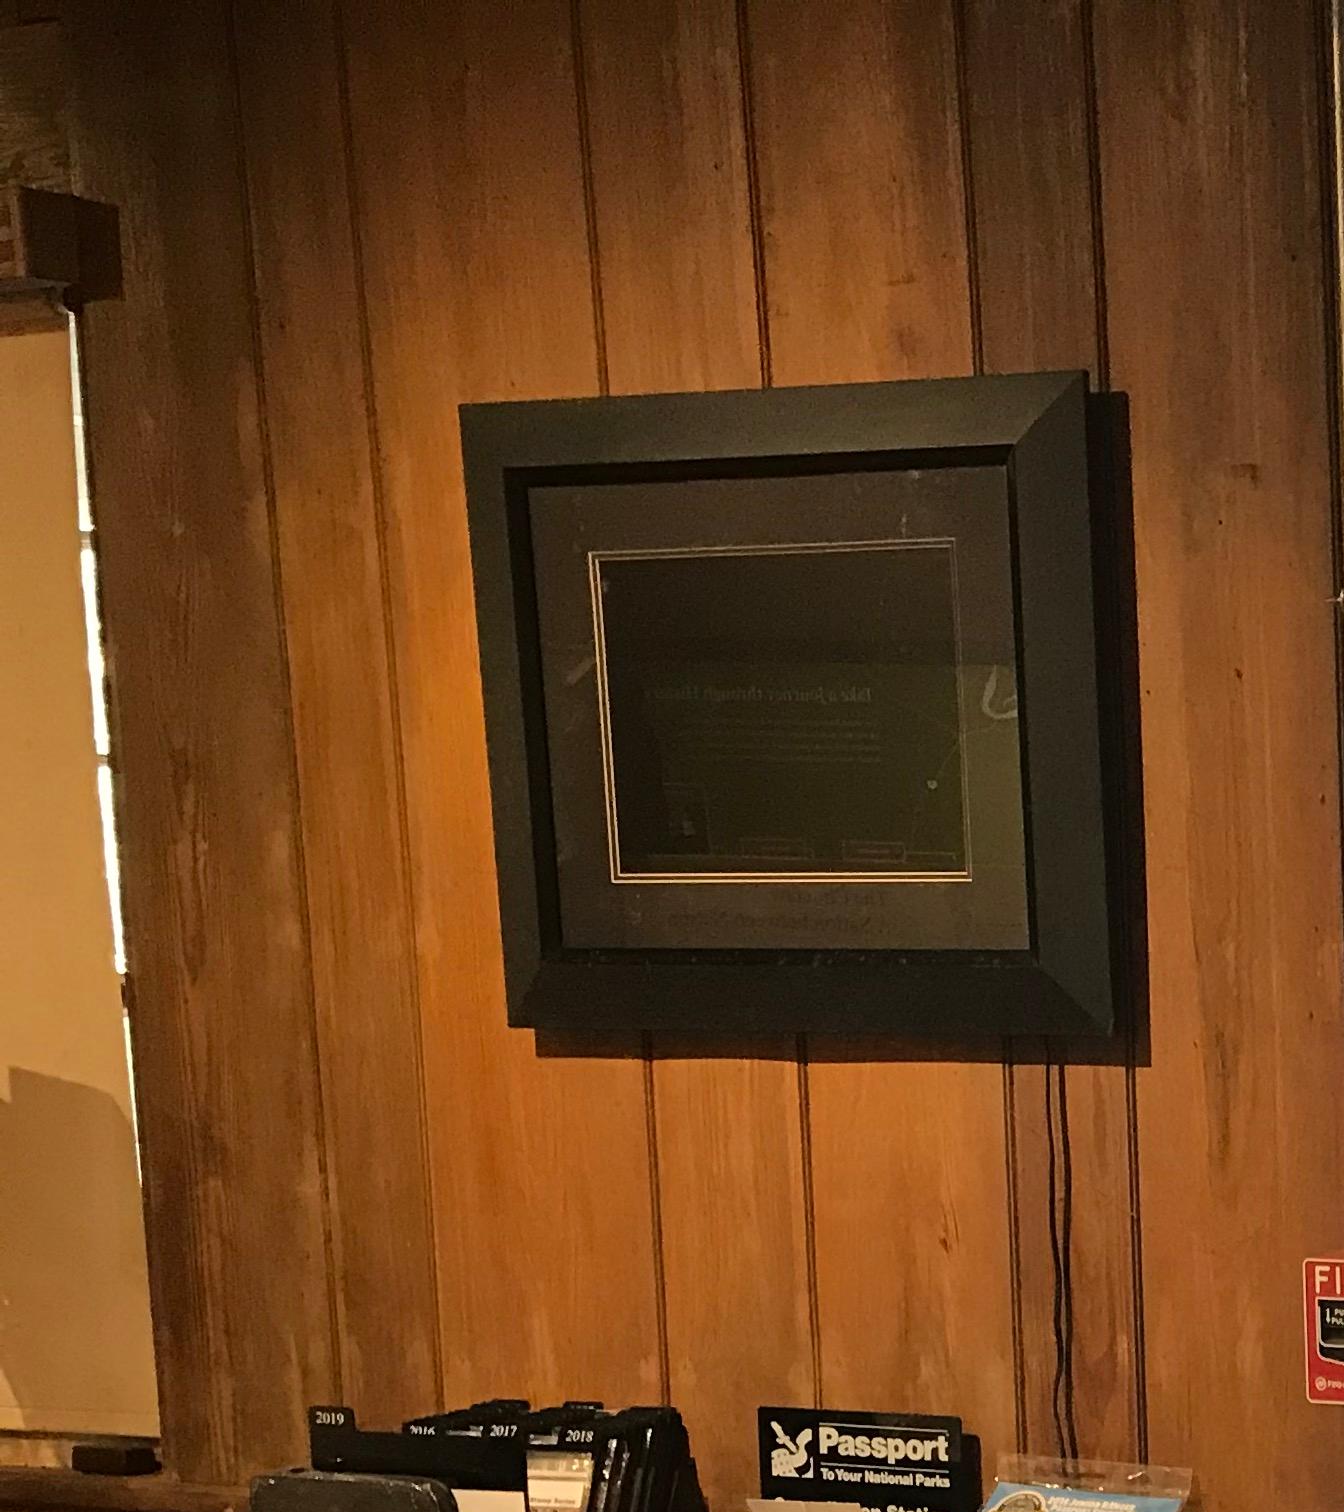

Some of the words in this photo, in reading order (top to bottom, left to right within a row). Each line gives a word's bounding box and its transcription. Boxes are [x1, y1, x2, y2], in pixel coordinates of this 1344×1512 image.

[315, 1410, 344, 1425] 2019
[490, 1424, 518, 1437] 2017
[565, 1429, 594, 1443] 2018
[819, 1426, 949, 1464] Passport
[820, 1468, 835, 1481] To
[835, 1469, 863, 1483] Your
[864, 1470, 914, 1486] National
[915, 1473, 950, 1488] Parks
